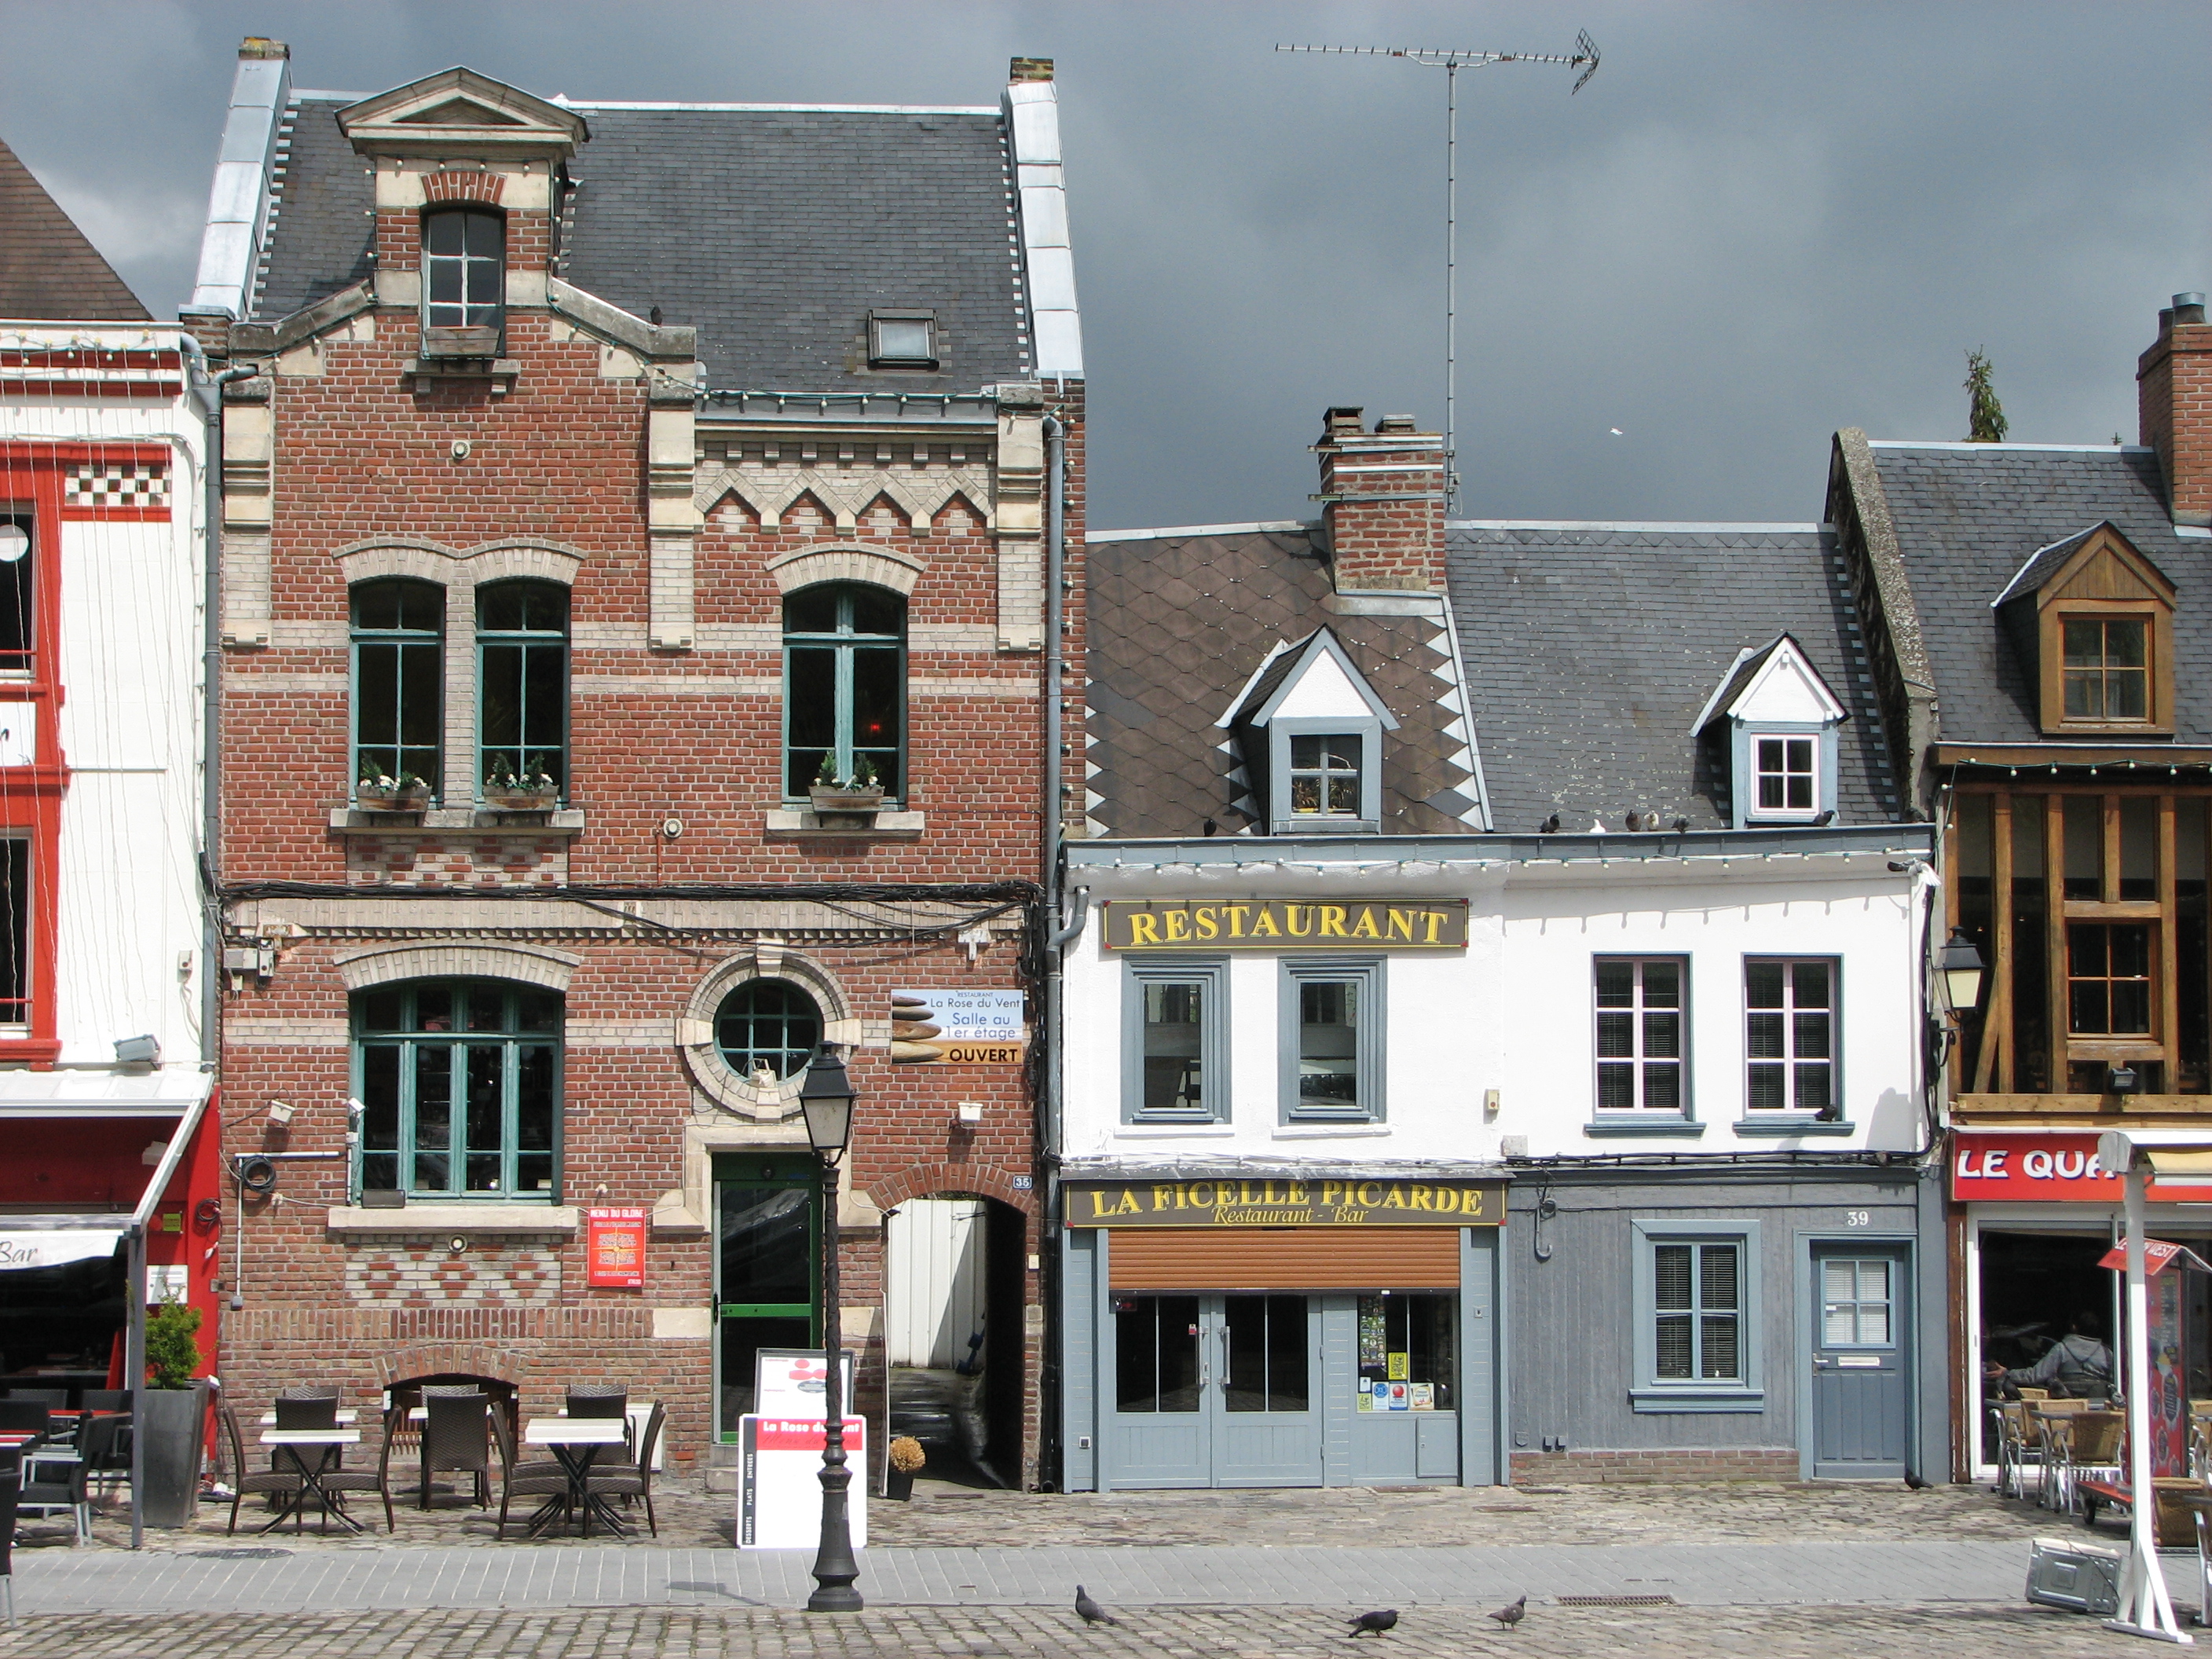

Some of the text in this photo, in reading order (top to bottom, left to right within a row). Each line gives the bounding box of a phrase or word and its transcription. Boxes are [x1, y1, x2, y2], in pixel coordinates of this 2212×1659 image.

[1127, 905, 1448, 946] RESTAURANT
[930, 998, 1020, 1008] La Rose du Vent
[952, 1013, 1010, 1025] Salle au
[946, 1026, 1016, 1041] 1er étage
[949, 1049, 1018, 1062] OUVERT
[1957, 1149, 2009, 1179] LE
[1016, 1177, 1030, 1187] 35
[1090, 1179, 1484, 1218] LA FICELLE PICARDE
[590, 1209, 609, 1218] MENU
[610, 1209, 620, 1218] DU
[1210, 1205, 1313, 1226] Restaurant
[1331, 1206, 1369, 1223] Bar
[1847, 1210, 1870, 1227] 39
[0, 1240, 38, 1263] Bar
[763, 1421, 777, 1432] La
[780, 1421, 809, 1432] Rose
